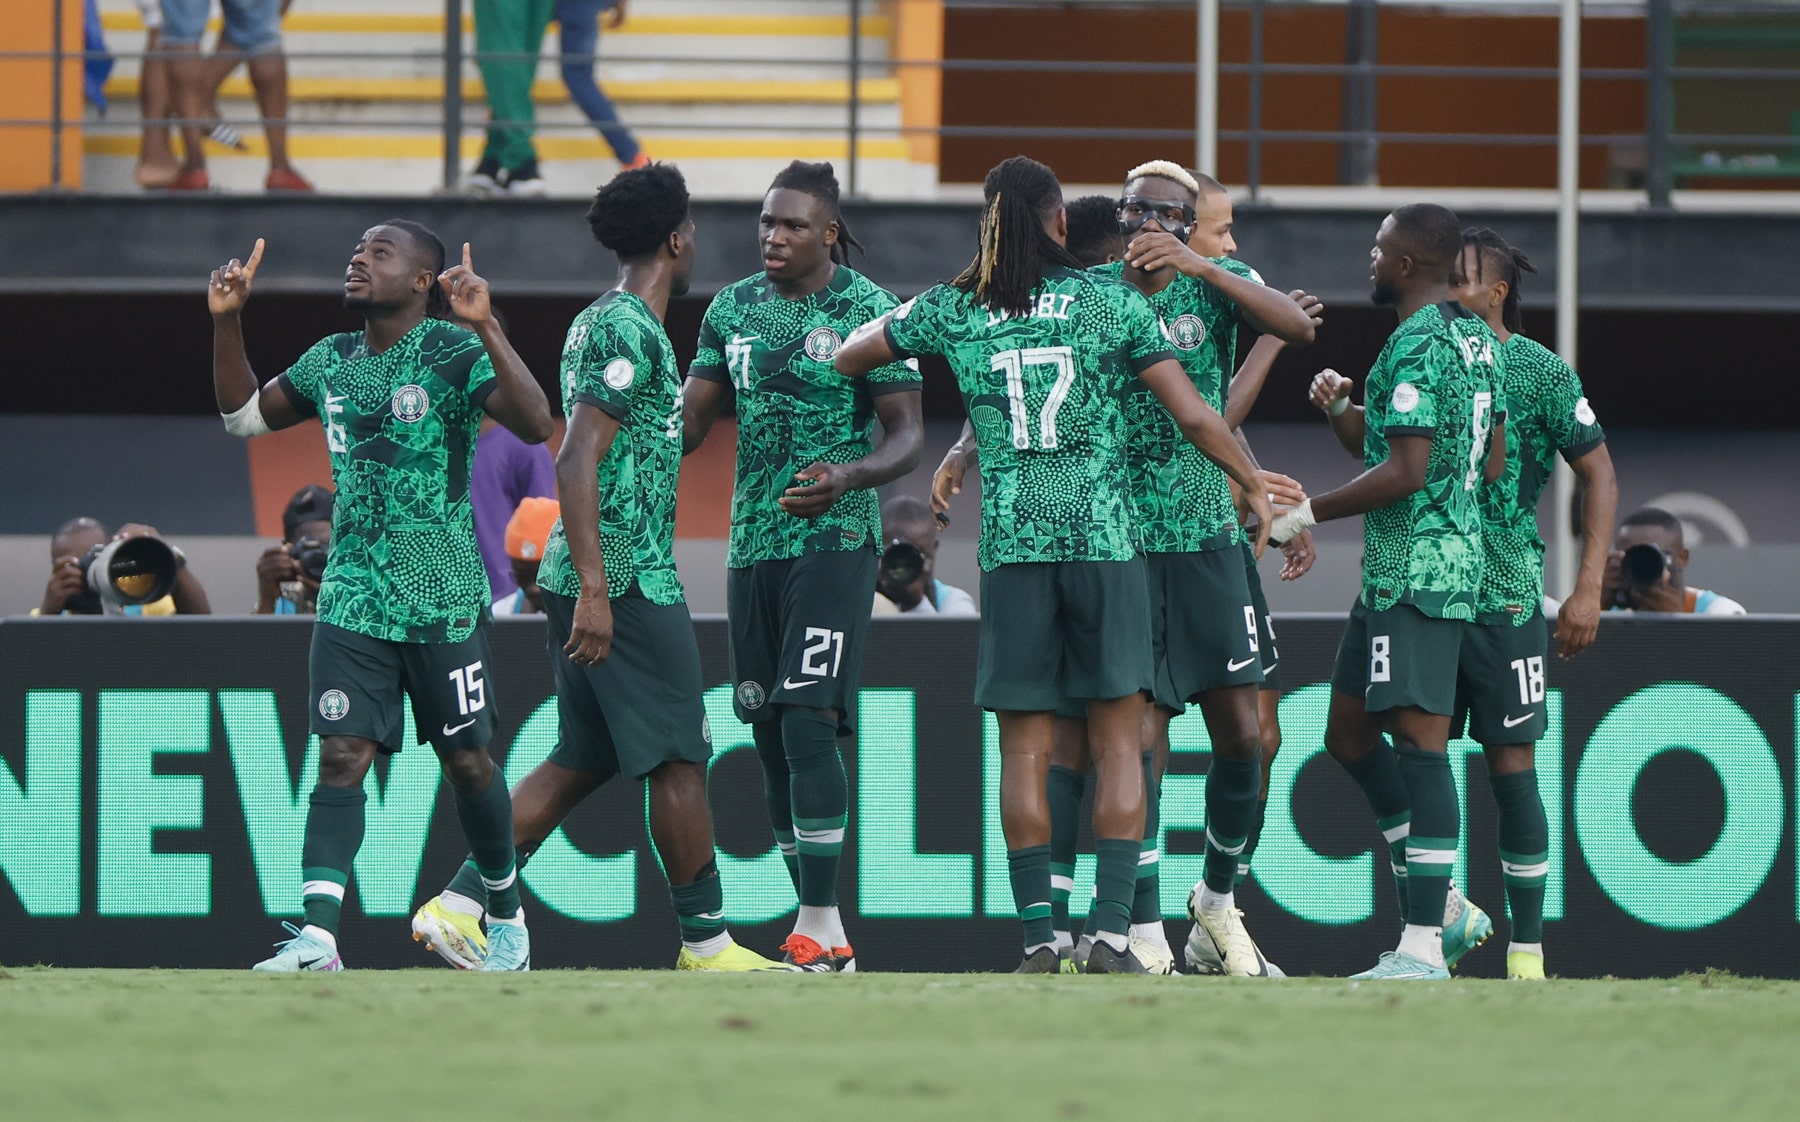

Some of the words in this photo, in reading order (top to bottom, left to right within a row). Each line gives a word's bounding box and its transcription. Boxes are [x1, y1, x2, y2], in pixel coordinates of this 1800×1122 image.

[981, 293, 1075, 327] IBI
[990, 346, 1075, 449] 17
[801, 627, 844, 678] 21
[1243, 605, 1259, 652] 9
[1370, 635, 1391, 682] 8
[1511, 655, 1545, 705] 18
[449, 660, 486, 715] 15
